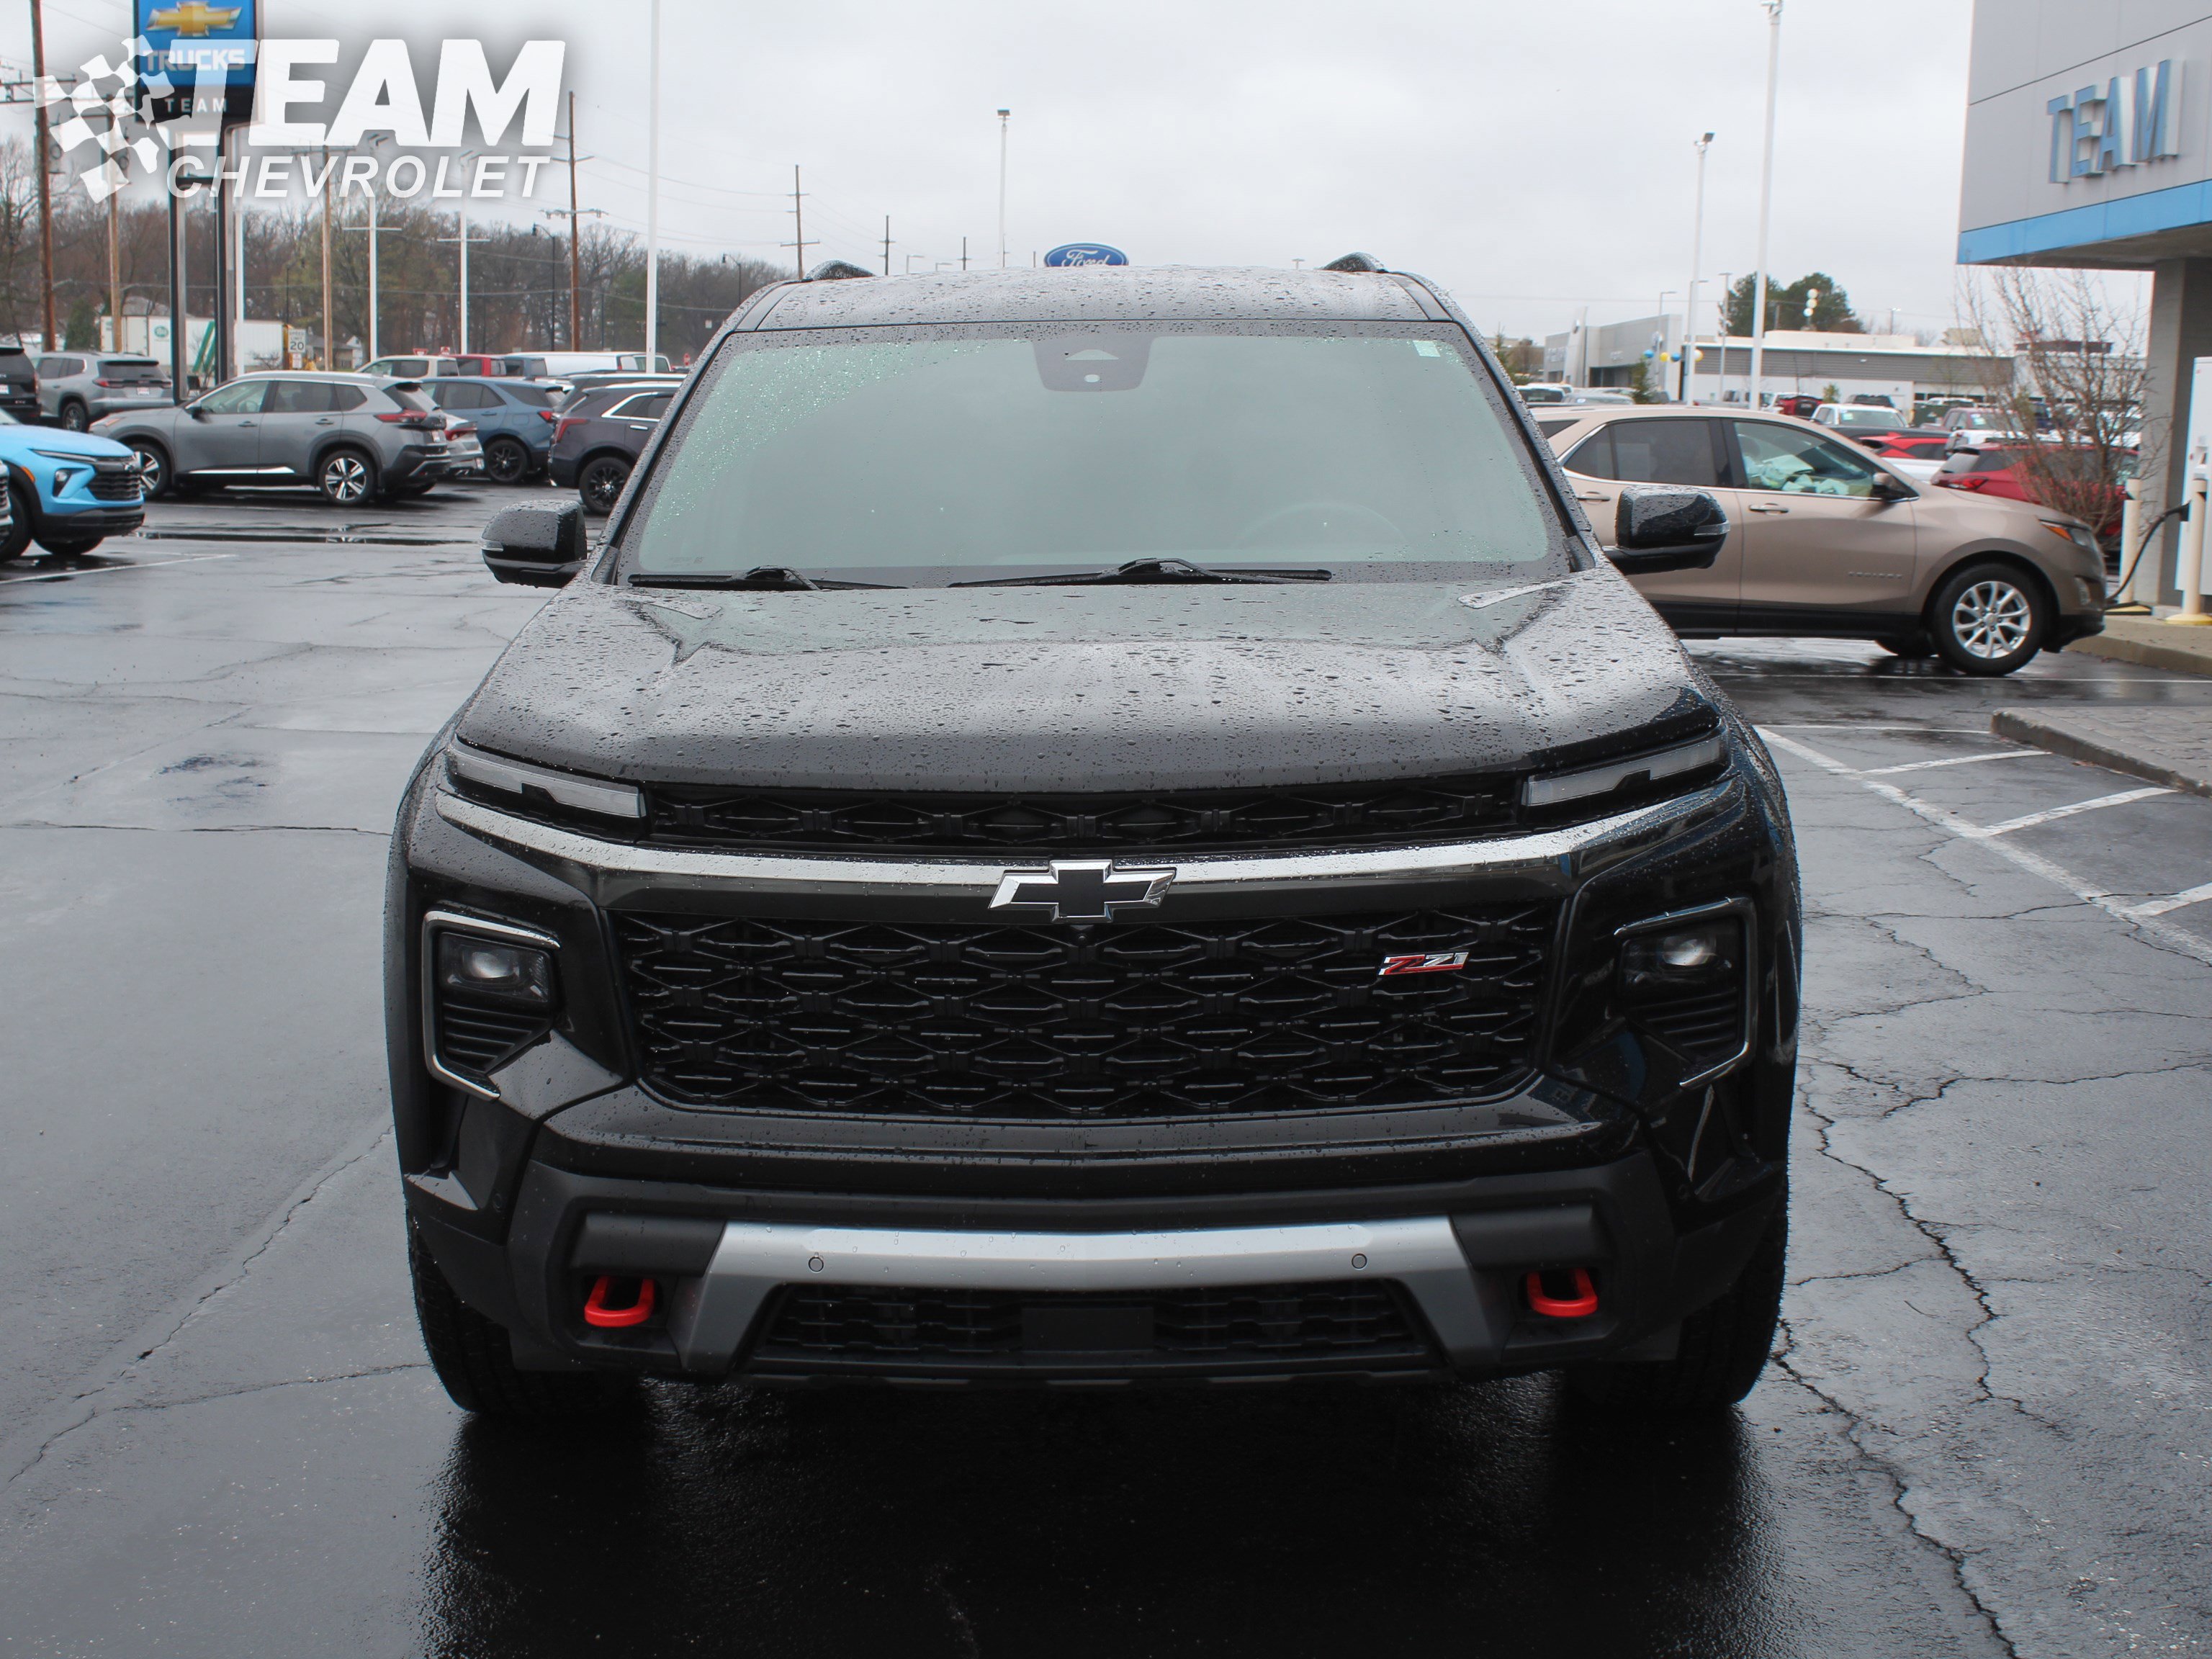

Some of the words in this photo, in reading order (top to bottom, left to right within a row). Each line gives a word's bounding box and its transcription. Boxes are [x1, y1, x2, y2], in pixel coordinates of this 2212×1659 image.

[142, 48, 246, 71] TRUCKS
[164, 97, 227, 112] TEAM
[2046, 59, 2185, 184] TEAM
[289, 341, 304, 350] 20
